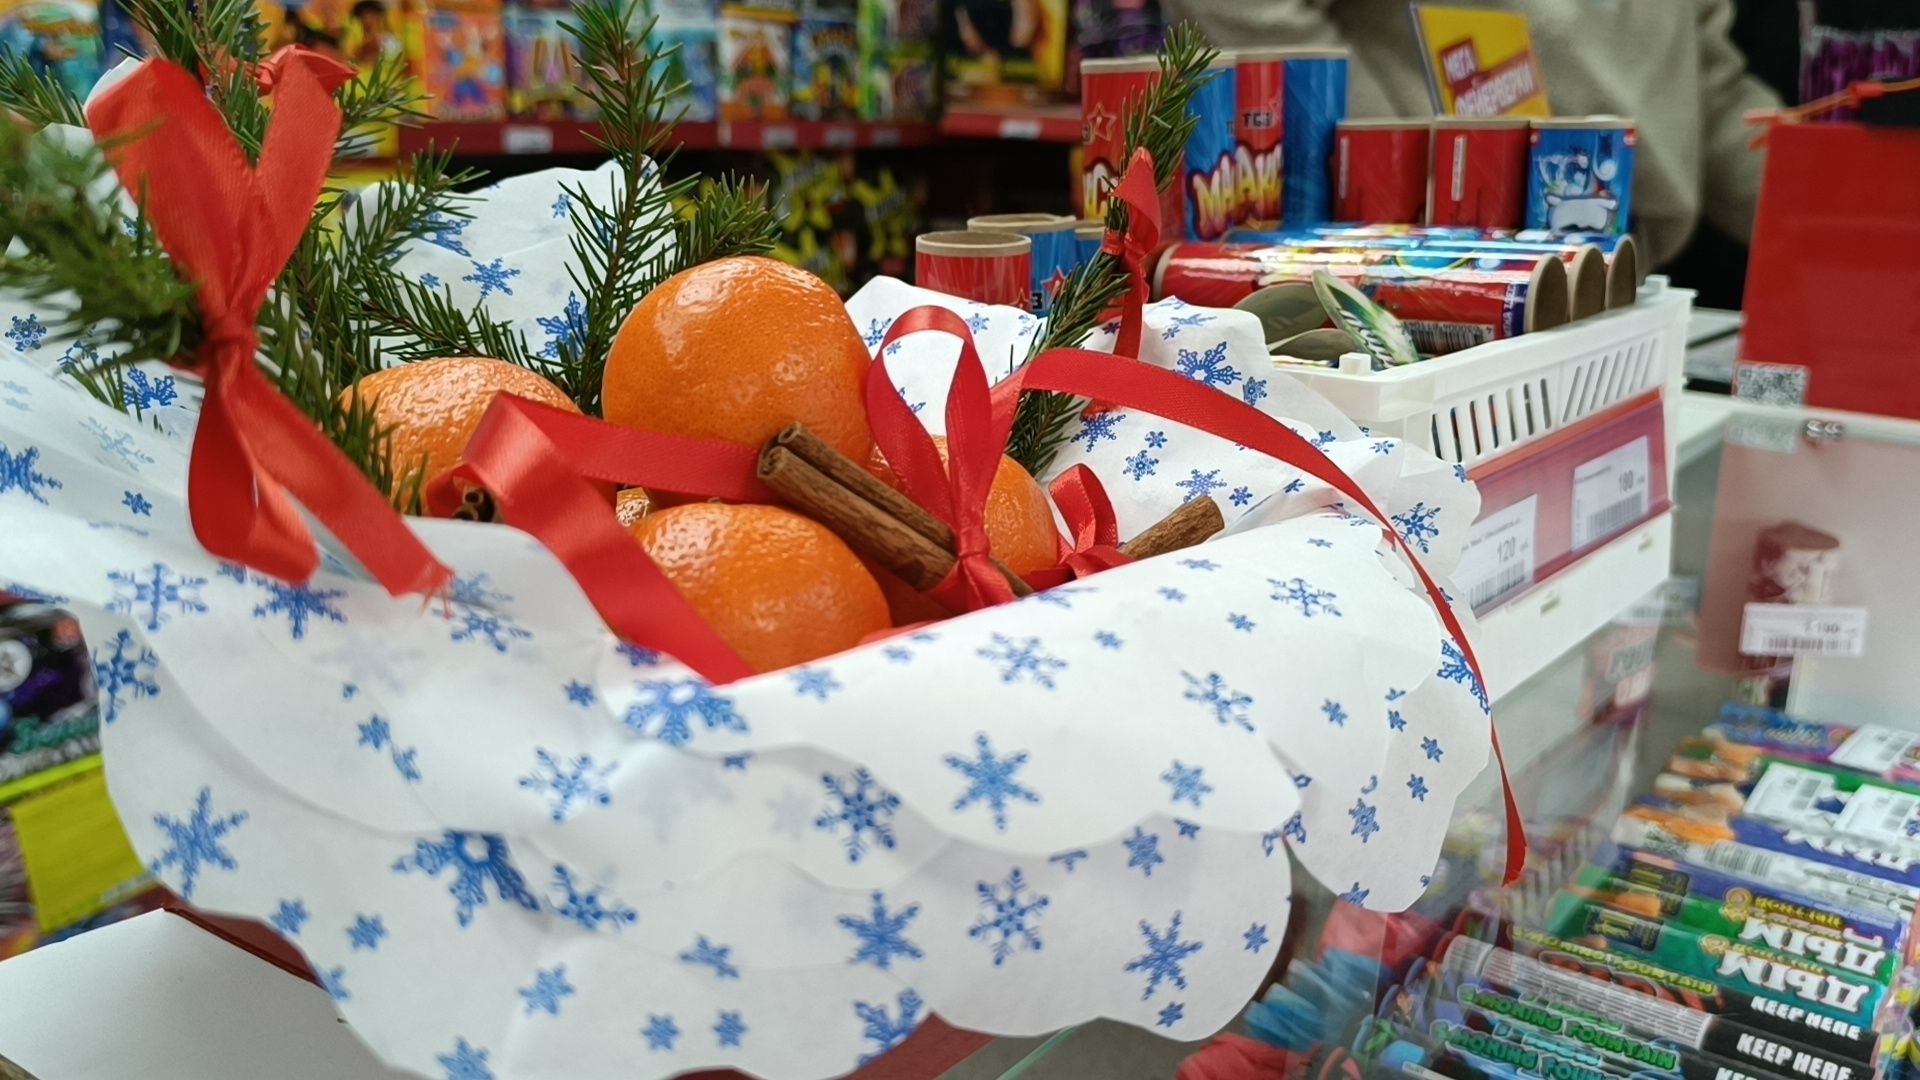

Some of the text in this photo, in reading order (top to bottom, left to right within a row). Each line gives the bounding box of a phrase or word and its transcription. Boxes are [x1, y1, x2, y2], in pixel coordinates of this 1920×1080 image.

[1497, 536, 1516, 562] 120
[1738, 916, 1886, 976] ДЫМ
[1716, 949, 1870, 1013] ДЫМ
[1750, 995, 1805, 1023] KEEP
[1565, 1019, 1679, 1072] FOUNTAIN
[1736, 1033, 1793, 1066] KEEP
[1792, 1051, 1852, 1080] HERE
